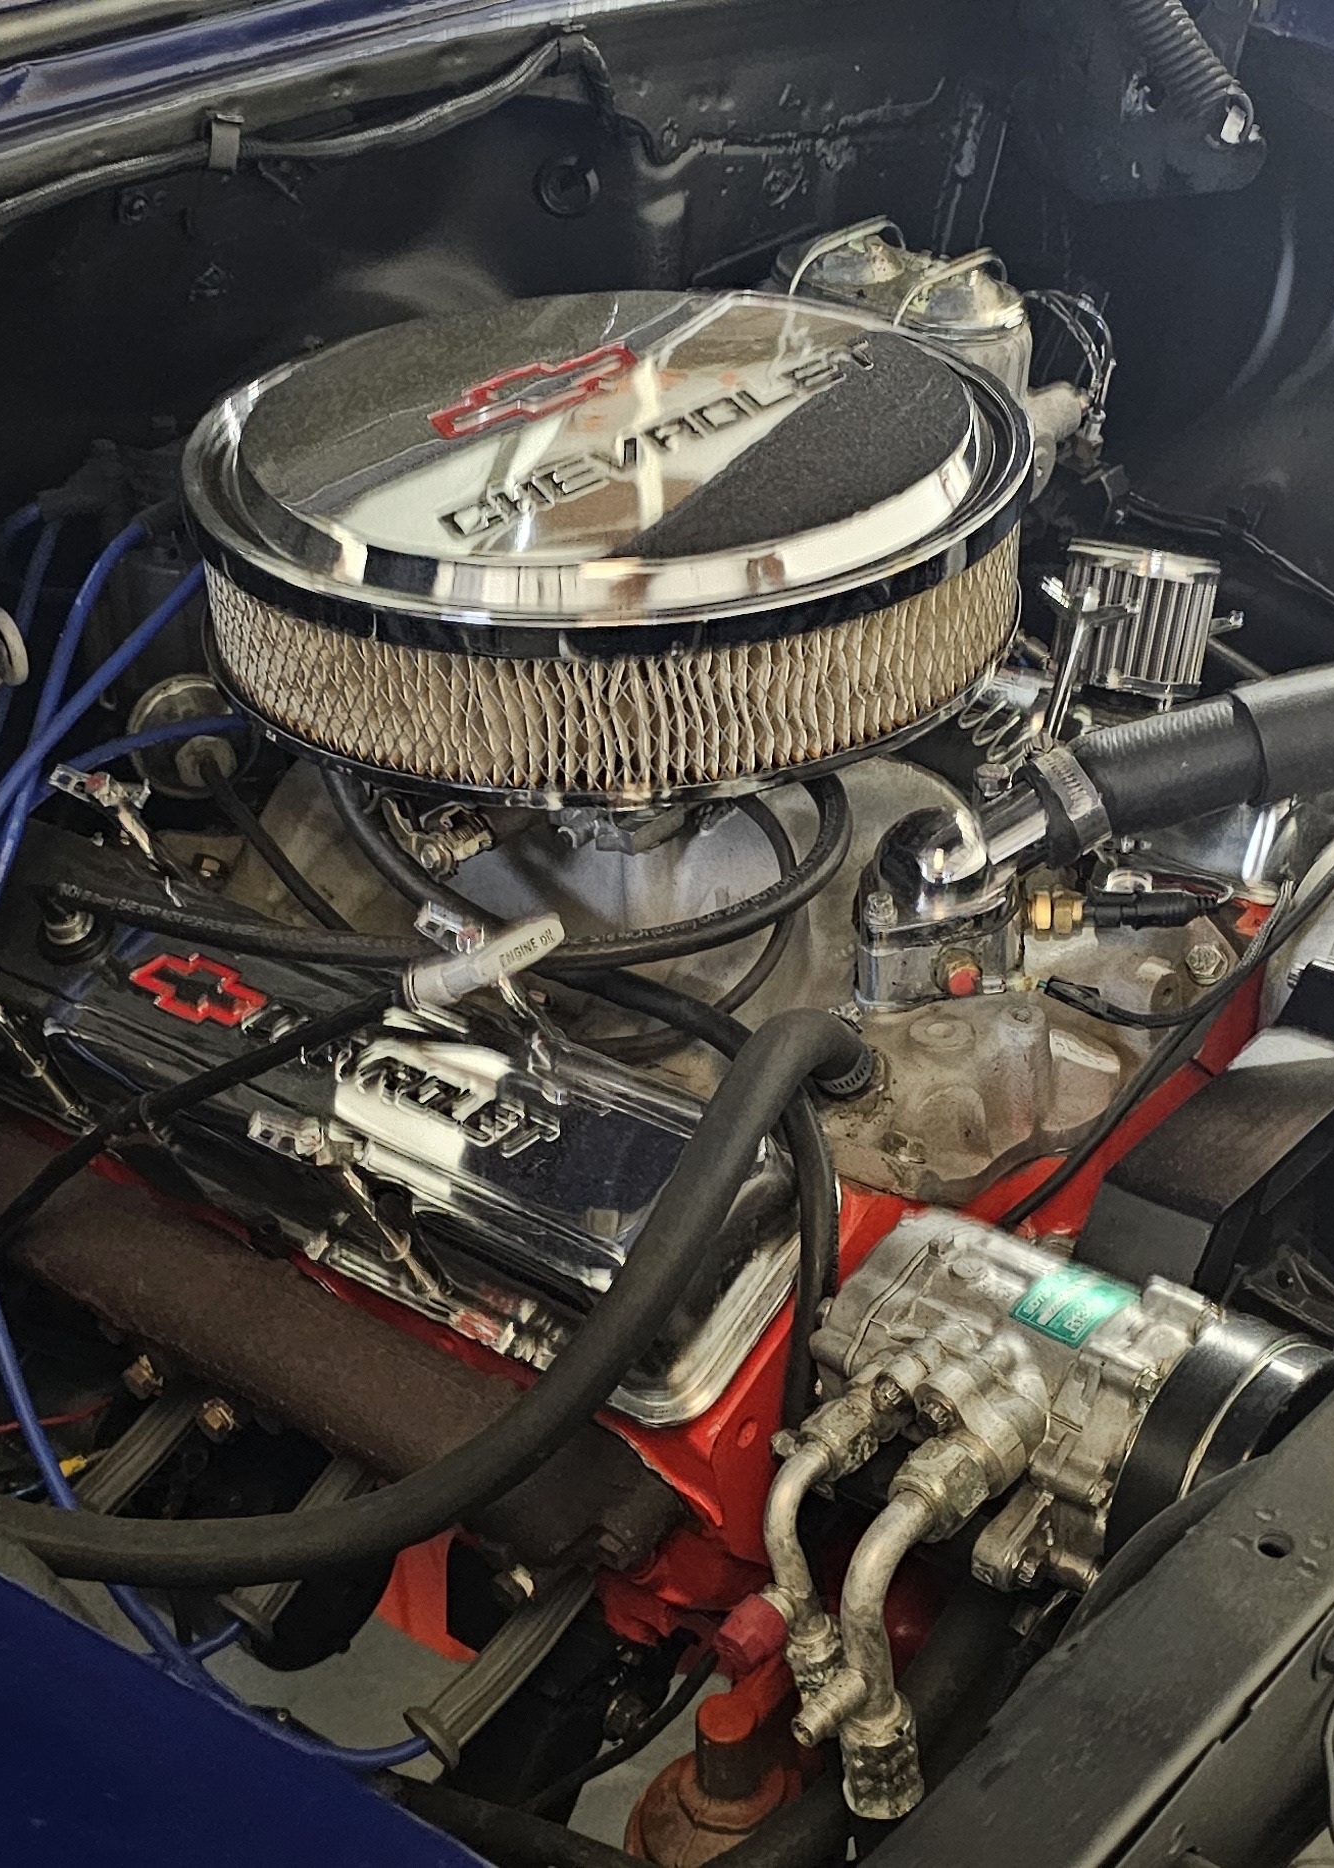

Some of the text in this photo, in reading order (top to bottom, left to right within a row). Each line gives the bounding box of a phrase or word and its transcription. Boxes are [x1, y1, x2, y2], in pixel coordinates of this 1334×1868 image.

[438, 338, 875, 538] CHEVROLET
[498, 928, 555, 968] ENGINE OIL
